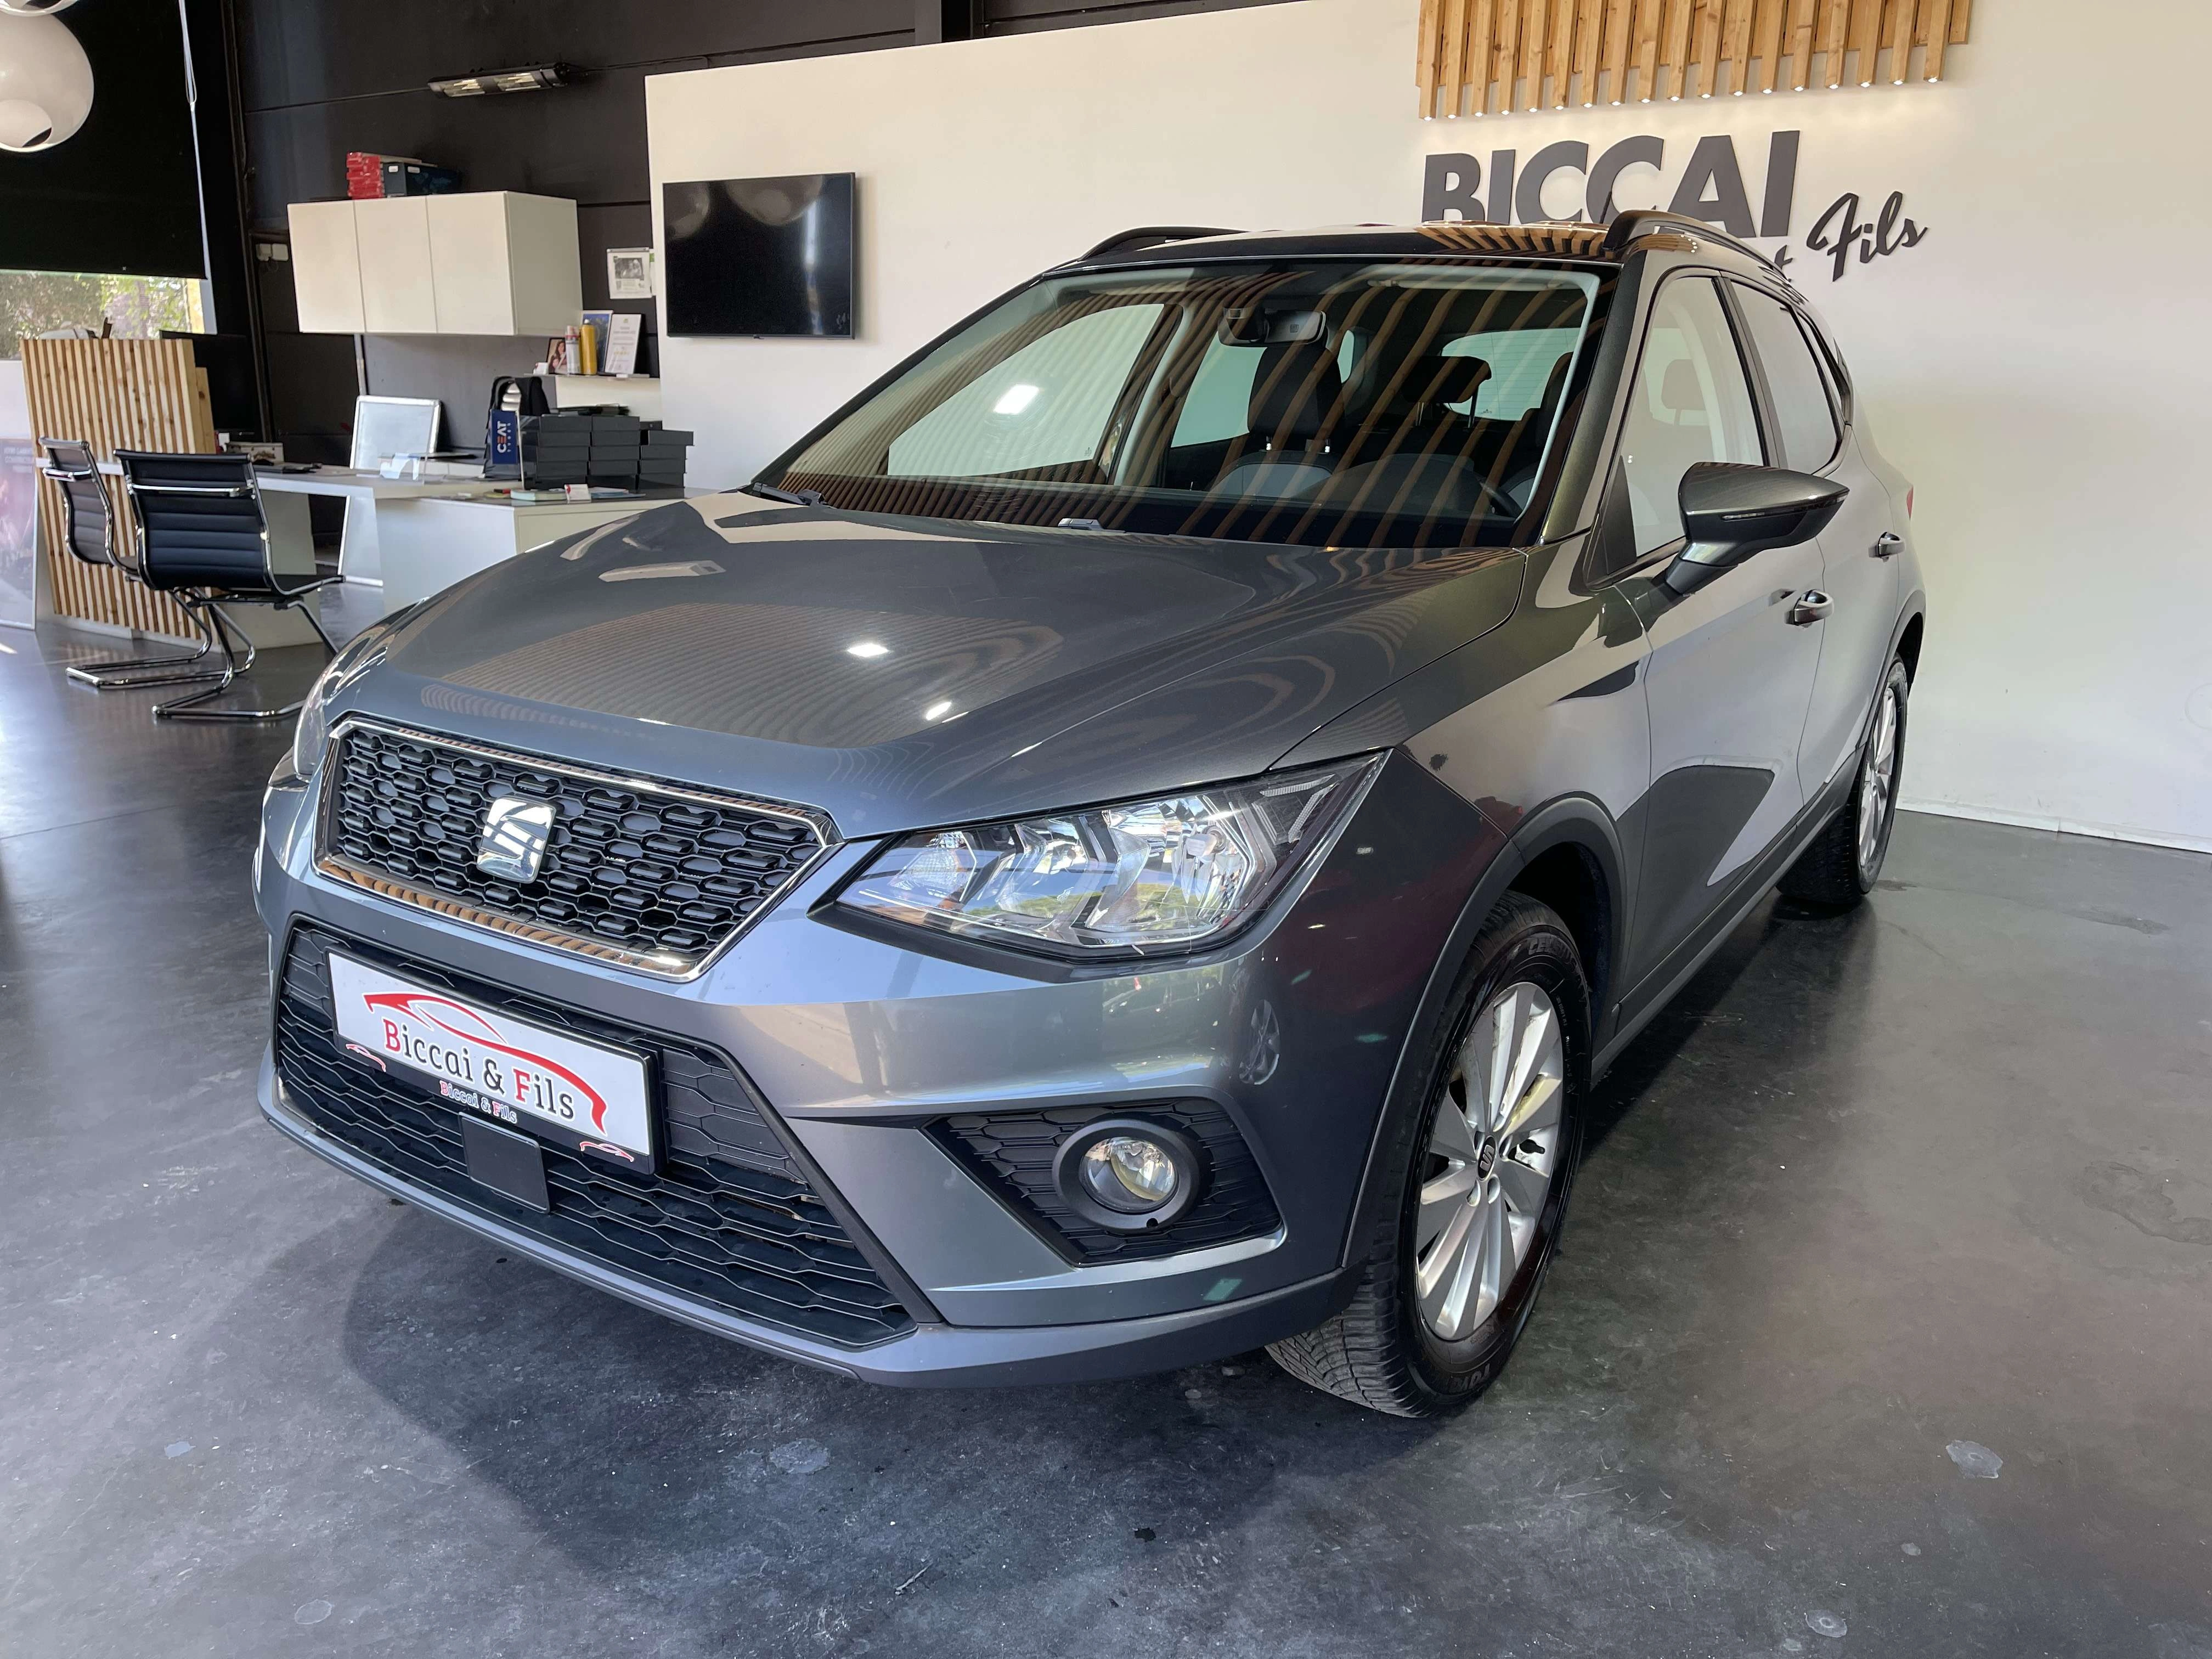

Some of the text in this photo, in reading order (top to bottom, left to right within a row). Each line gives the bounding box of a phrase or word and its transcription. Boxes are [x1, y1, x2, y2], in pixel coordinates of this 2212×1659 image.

[1421, 129, 1800, 238] BICCAI
[1807, 191, 1928, 282] Fils
[381, 1018, 574, 1120] Biccai & Fils
[439, 1080, 517, 1124] Biccai & Fils
